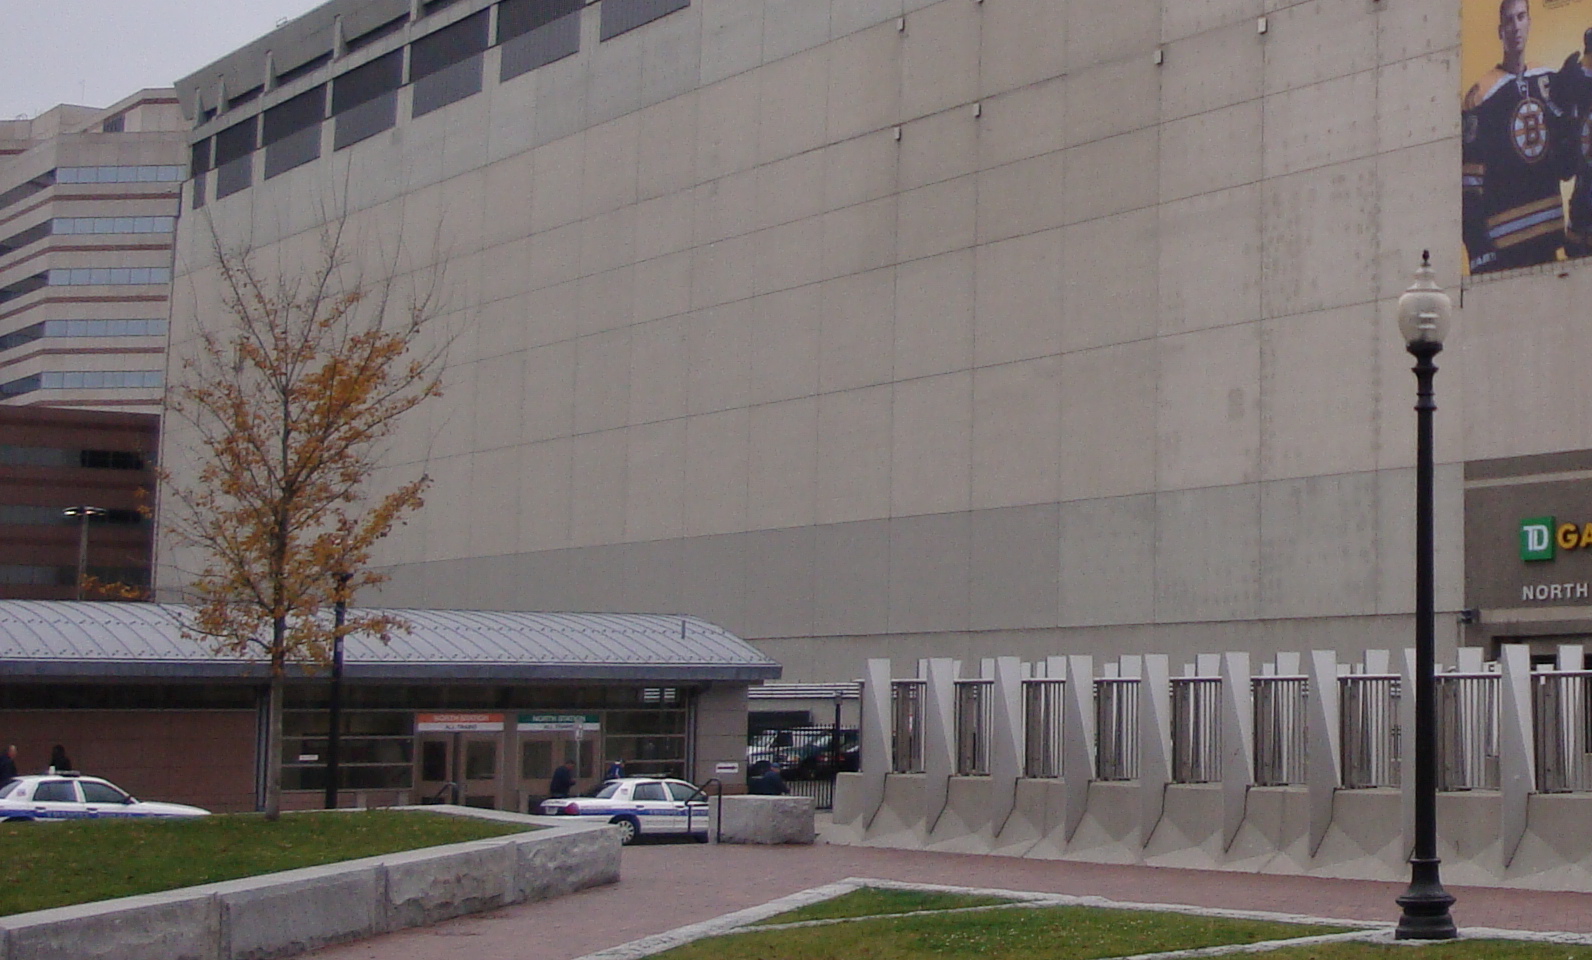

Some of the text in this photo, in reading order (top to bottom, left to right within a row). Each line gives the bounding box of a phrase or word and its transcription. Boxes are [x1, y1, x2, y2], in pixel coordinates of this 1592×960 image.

[1523, 525, 1549, 551] TD
[1522, 583, 1588, 601] NORTH
[433, 713, 490, 722] NORTH STATION
[532, 714, 556, 722] NORTH
